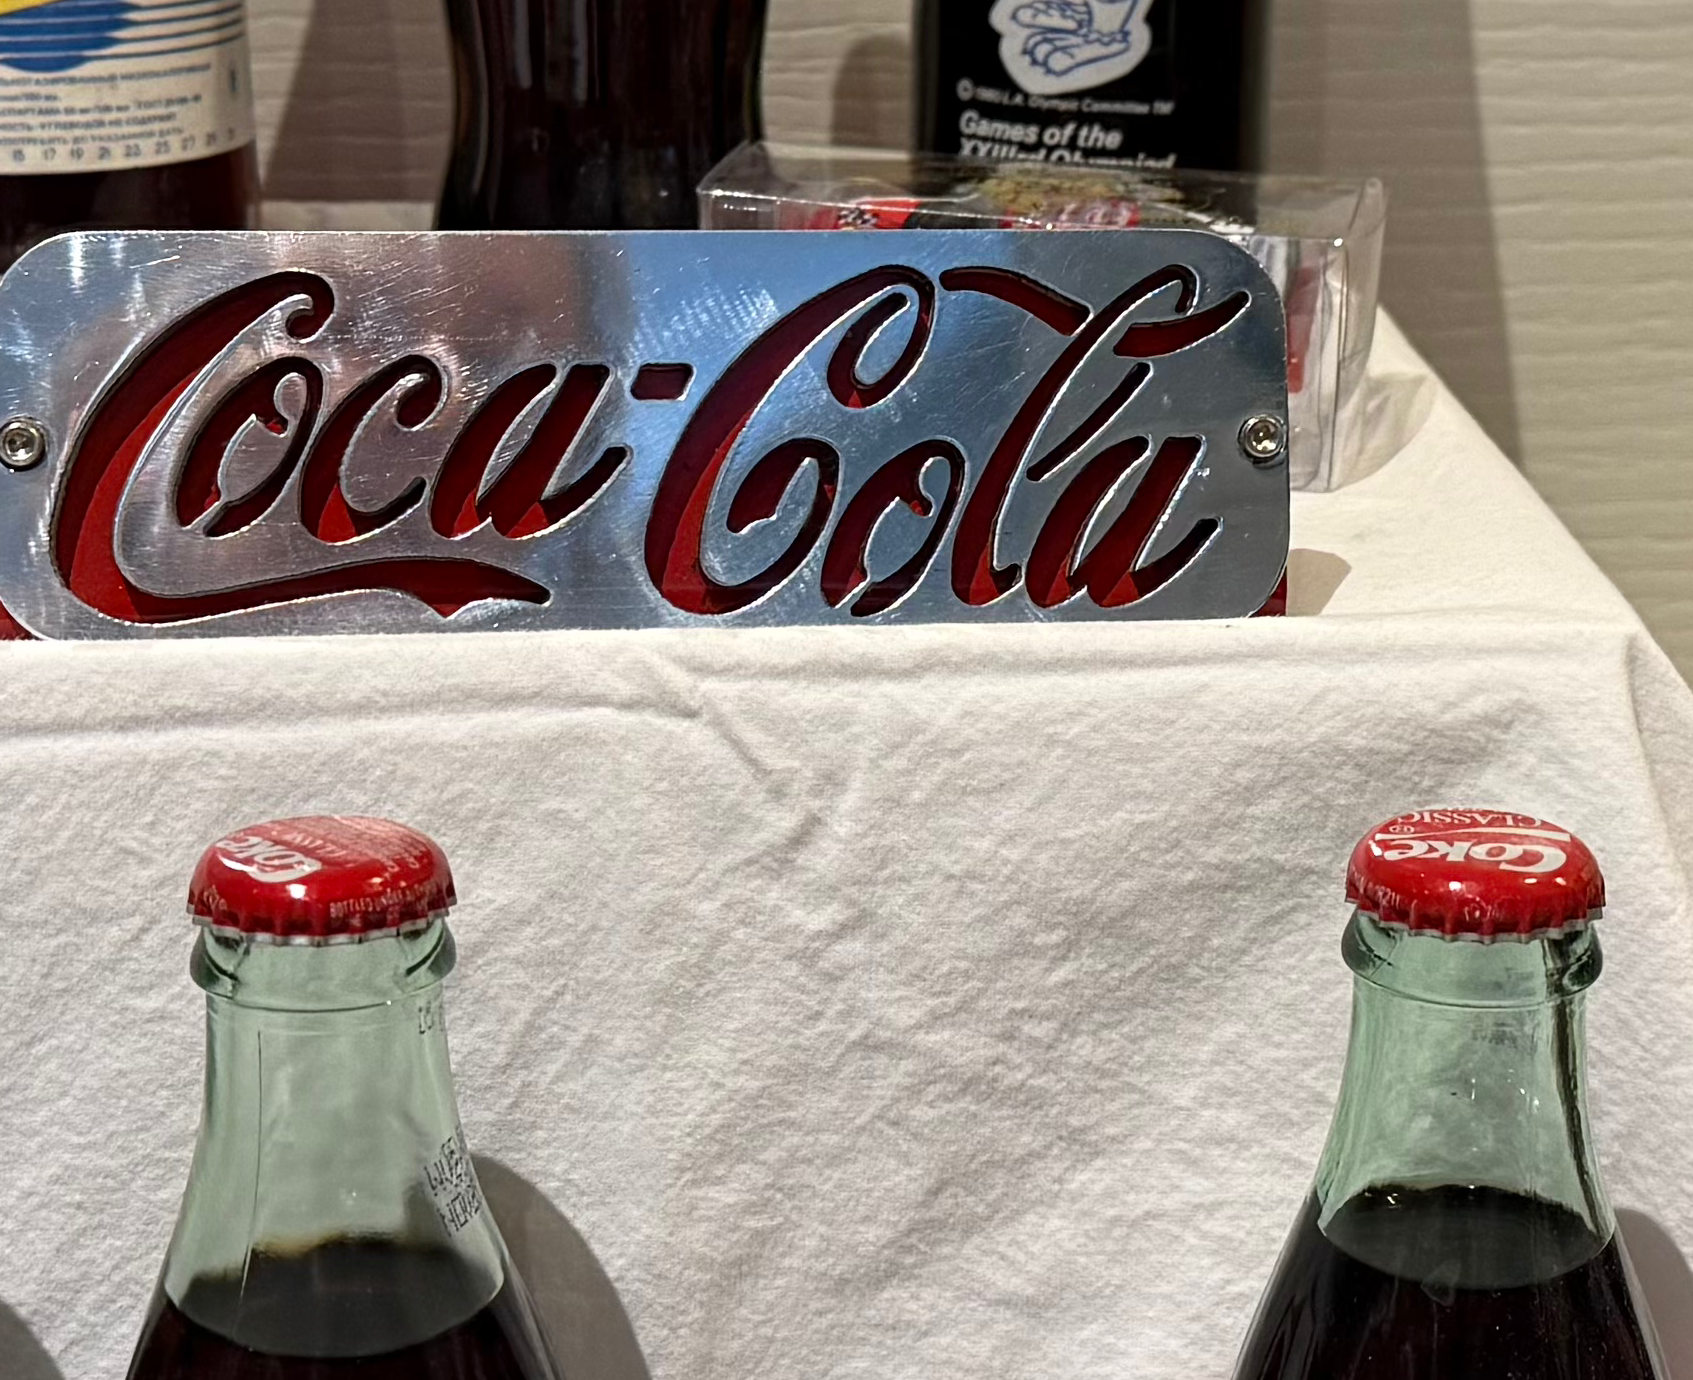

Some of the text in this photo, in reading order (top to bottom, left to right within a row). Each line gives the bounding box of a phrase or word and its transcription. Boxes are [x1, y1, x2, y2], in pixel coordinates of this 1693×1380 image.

[959, 108, 1123, 150] Games of the
[52, 266, 1249, 623] Coca-Cola
[1397, 811, 1543, 830] CLASSIC
[214, 834, 323, 884] Coke
[1383, 839, 1568, 874] Coke
[329, 896, 373, 919] BOTTLED
